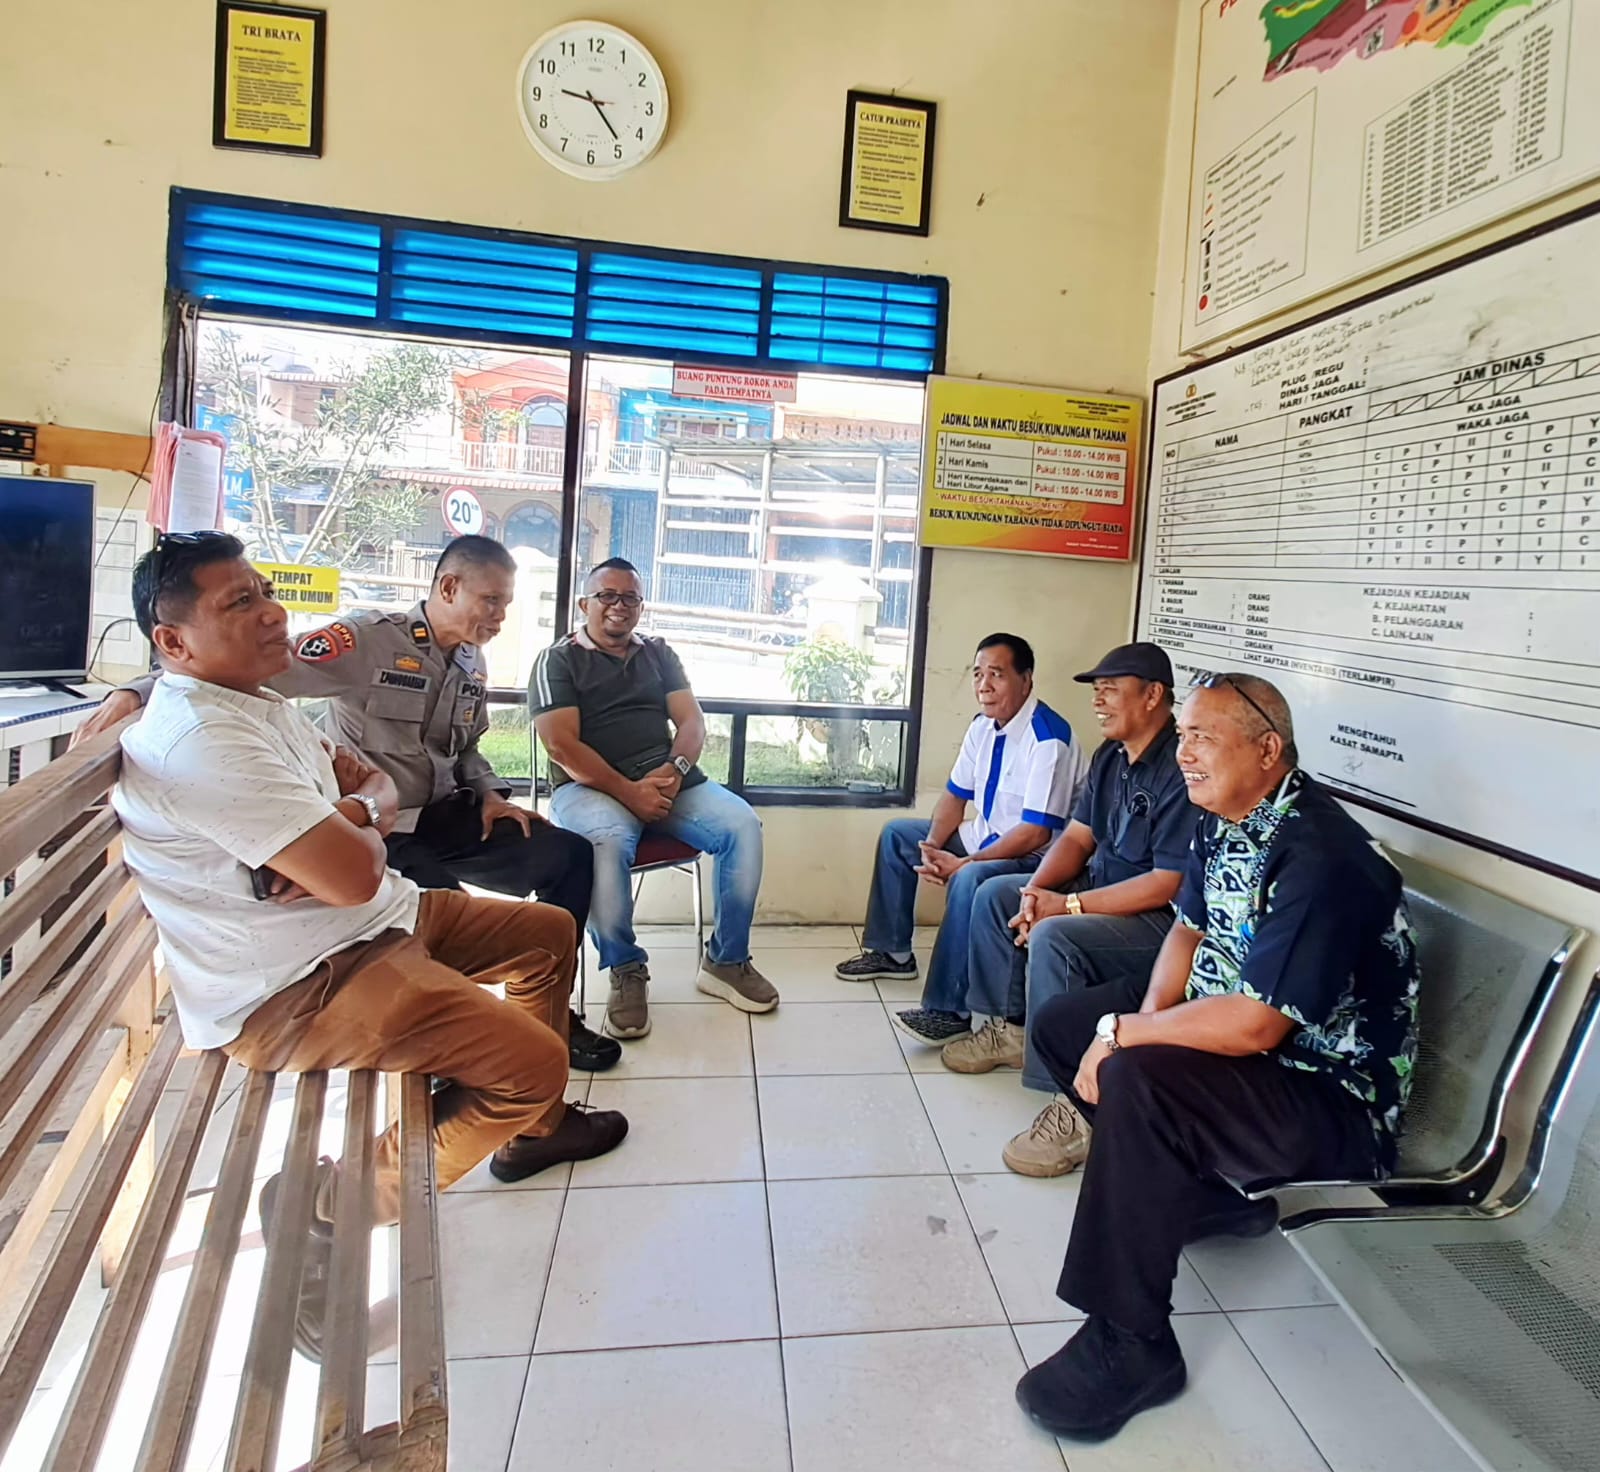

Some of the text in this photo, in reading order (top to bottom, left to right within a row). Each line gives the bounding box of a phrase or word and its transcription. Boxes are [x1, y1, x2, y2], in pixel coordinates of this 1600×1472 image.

[242, 25, 301, 42] TRI BRATA
[560, 41, 575, 57] 11
[588, 38, 604, 53] 12
[620, 50, 625, 64] 1
[539, 59, 555, 74] 10
[638, 73, 646, 87] 2
[533, 87, 541, 101] 9
[645, 102, 653, 116] 3
[540, 114, 547, 128] 8
[860, 112, 921, 128] CATUR PRASETYA
[636, 128, 643, 141] 4
[560, 138, 568, 152] 7
[614, 145, 622, 159] 5
[587, 150, 595, 165] 6
[1454, 352, 1544, 385] JAM DINAS
[677, 371, 793, 389] BUANG PUNTUNG ROKOK ANDA
[1280, 375, 1339, 399] DINAS JAGA
[1281, 372, 1306, 388] PLUG
[705, 385, 771, 399] PADA TEMPATNYA
[1279, 397, 1302, 410] HARI
[1467, 396, 1521, 413] KA JAGA
[1299, 406, 1353, 428] PANGKAT
[1457, 411, 1529, 431] WAKA JAGA
[941, 412, 971, 426] JADWAL
[973, 416, 988, 428] DAN
[990, 417, 1017, 431] WAKTU
[1094, 428, 1126, 442] TAHANAN
[950, 439, 965, 447] Hari
[967, 440, 991, 450] Selasa
[1215, 435, 1238, 448] NAMA
[1375, 452, 1381, 460] C
[1403, 448, 1410, 456] P
[1435, 443, 1441, 451] Y
[1505, 432, 1513, 440] C
[1546, 425, 1554, 434] P
[1590, 418, 1599, 428] Y
[1038, 447, 1057, 456] Pukul
[1107, 454, 1120, 462] WIB
[1166, 450, 1175, 458] NO
[1433, 459, 1440, 468] P
[1467, 455, 1474, 463] Y
[1544, 444, 1552, 453] C
[1589, 438, 1597, 447] P
[949, 458, 964, 466] Hari
[966, 458, 988, 468] Kamis
[1465, 472, 1472, 480] P
[1502, 467, 1510, 476] Y
[1586, 457, 1596, 467] C
[1036, 465, 1056, 474] Pukul
[1106, 472, 1119, 480] WIB
[984, 484, 1008, 492] Agama
[1035, 483, 1054, 492] Pukul
[1105, 490, 1118, 498] WIB
[1464, 489, 1471, 497] C
[1500, 485, 1508, 494] P
[1541, 481, 1549, 490] Y
[941, 494, 966, 502] WAKTU
[451, 499, 471, 523] 20
[1370, 512, 1376, 520] C
[1398, 510, 1404, 518] P
[1498, 503, 1506, 511] C
[1538, 500, 1547, 509] P
[1583, 497, 1592, 506] Y
[1005, 515, 1039, 526] TAHANAN
[272, 571, 312, 585] TEMPAT
[275, 588, 333, 603] GER UMUM
[1248, 593, 1270, 601] ORANG
[1363, 588, 1470, 600] KEJADIAN KEJADIAN
[1248, 604, 1269, 612] ORANG
[1373, 602, 1446, 613] A. KEJAHATAN
[1247, 615, 1268, 623] ORANG
[1373, 615, 1463, 630] B. PELANGGARAN
[1246, 629, 1267, 637] ORANG
[1372, 628, 1434, 641] C. LAIN-LAIN
[1245, 641, 1273, 650] ORGANIK
[1263, 657, 1288, 667] DAFTAR
[1338, 669, 1395, 688] (TERLAMPIR)
[1338, 724, 1396, 746] MENGETAHUI
[1330, 735, 1404, 762] KASAT SAMAPTA
